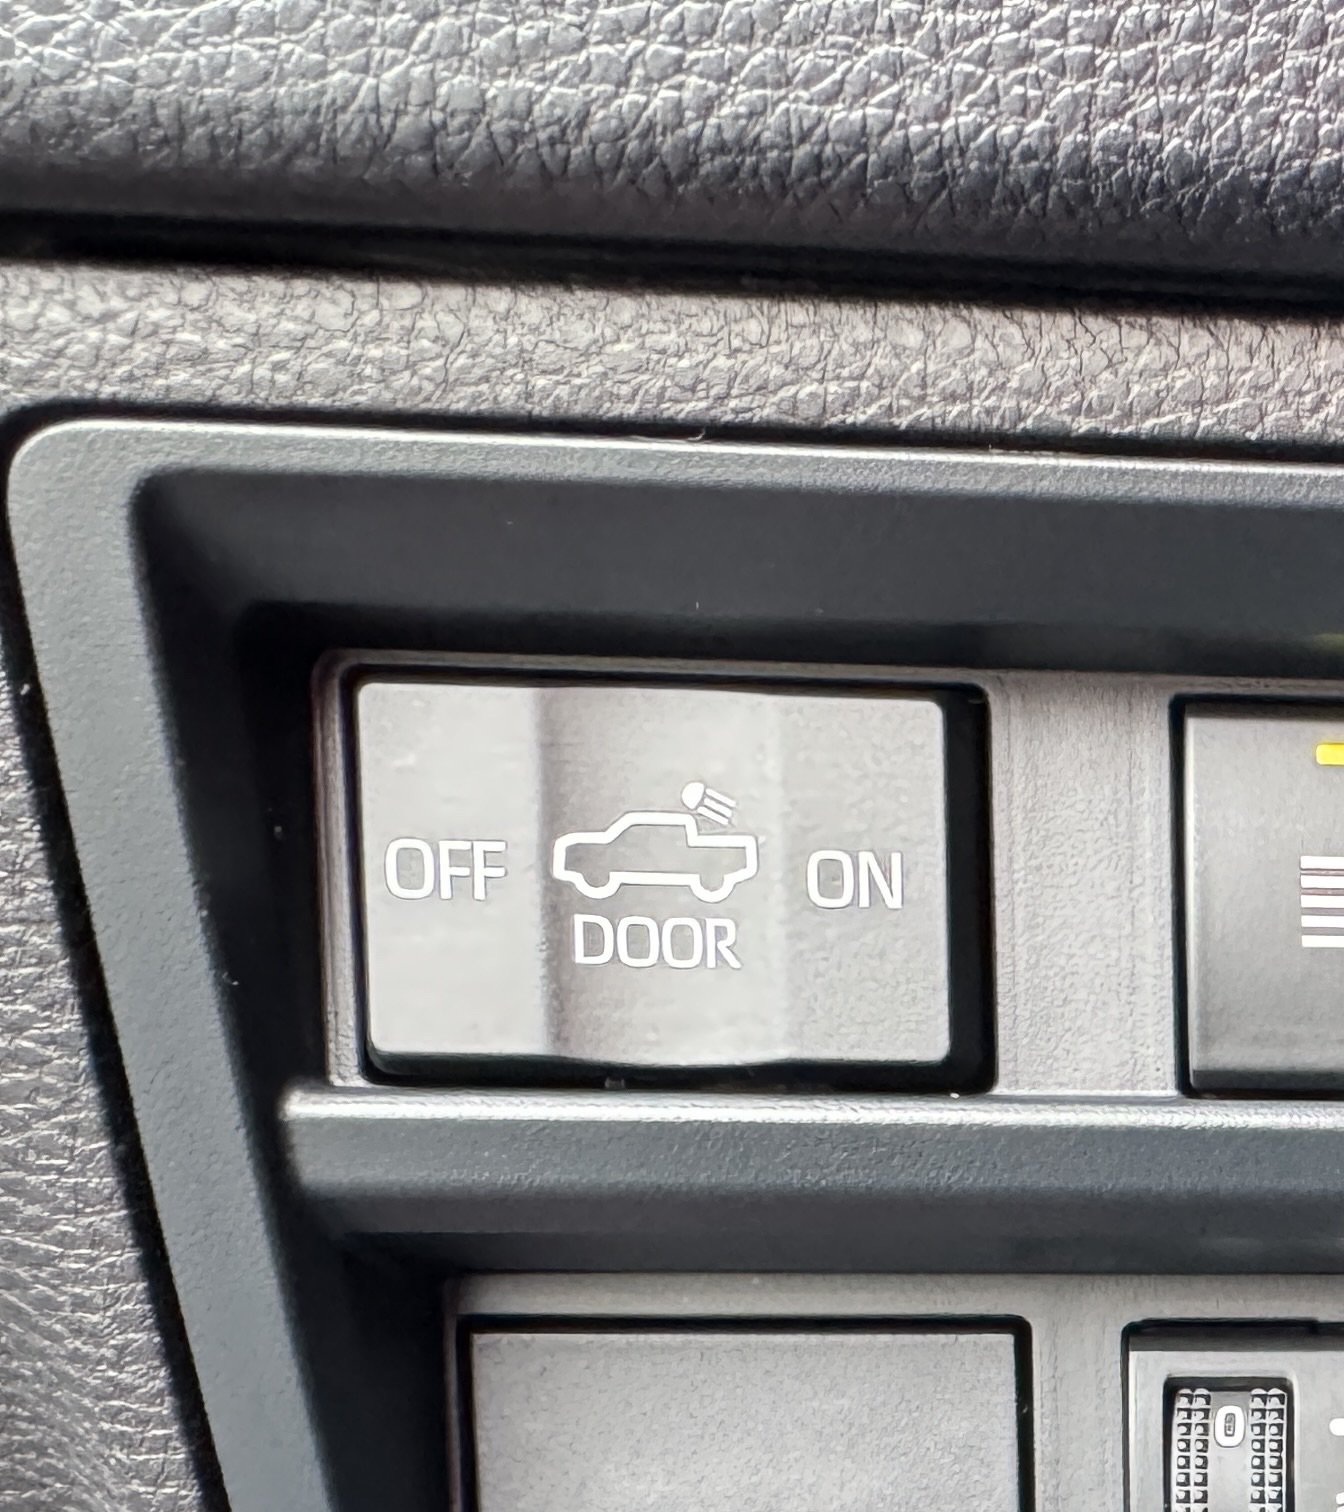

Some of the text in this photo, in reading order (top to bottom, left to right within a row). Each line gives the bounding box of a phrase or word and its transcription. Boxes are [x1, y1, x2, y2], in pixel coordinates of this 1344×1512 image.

[383, 837, 507, 900] OFF
[805, 850, 903, 909] ON
[572, 914, 742, 970] DOOR
[1214, 1405, 1245, 1447] 0
